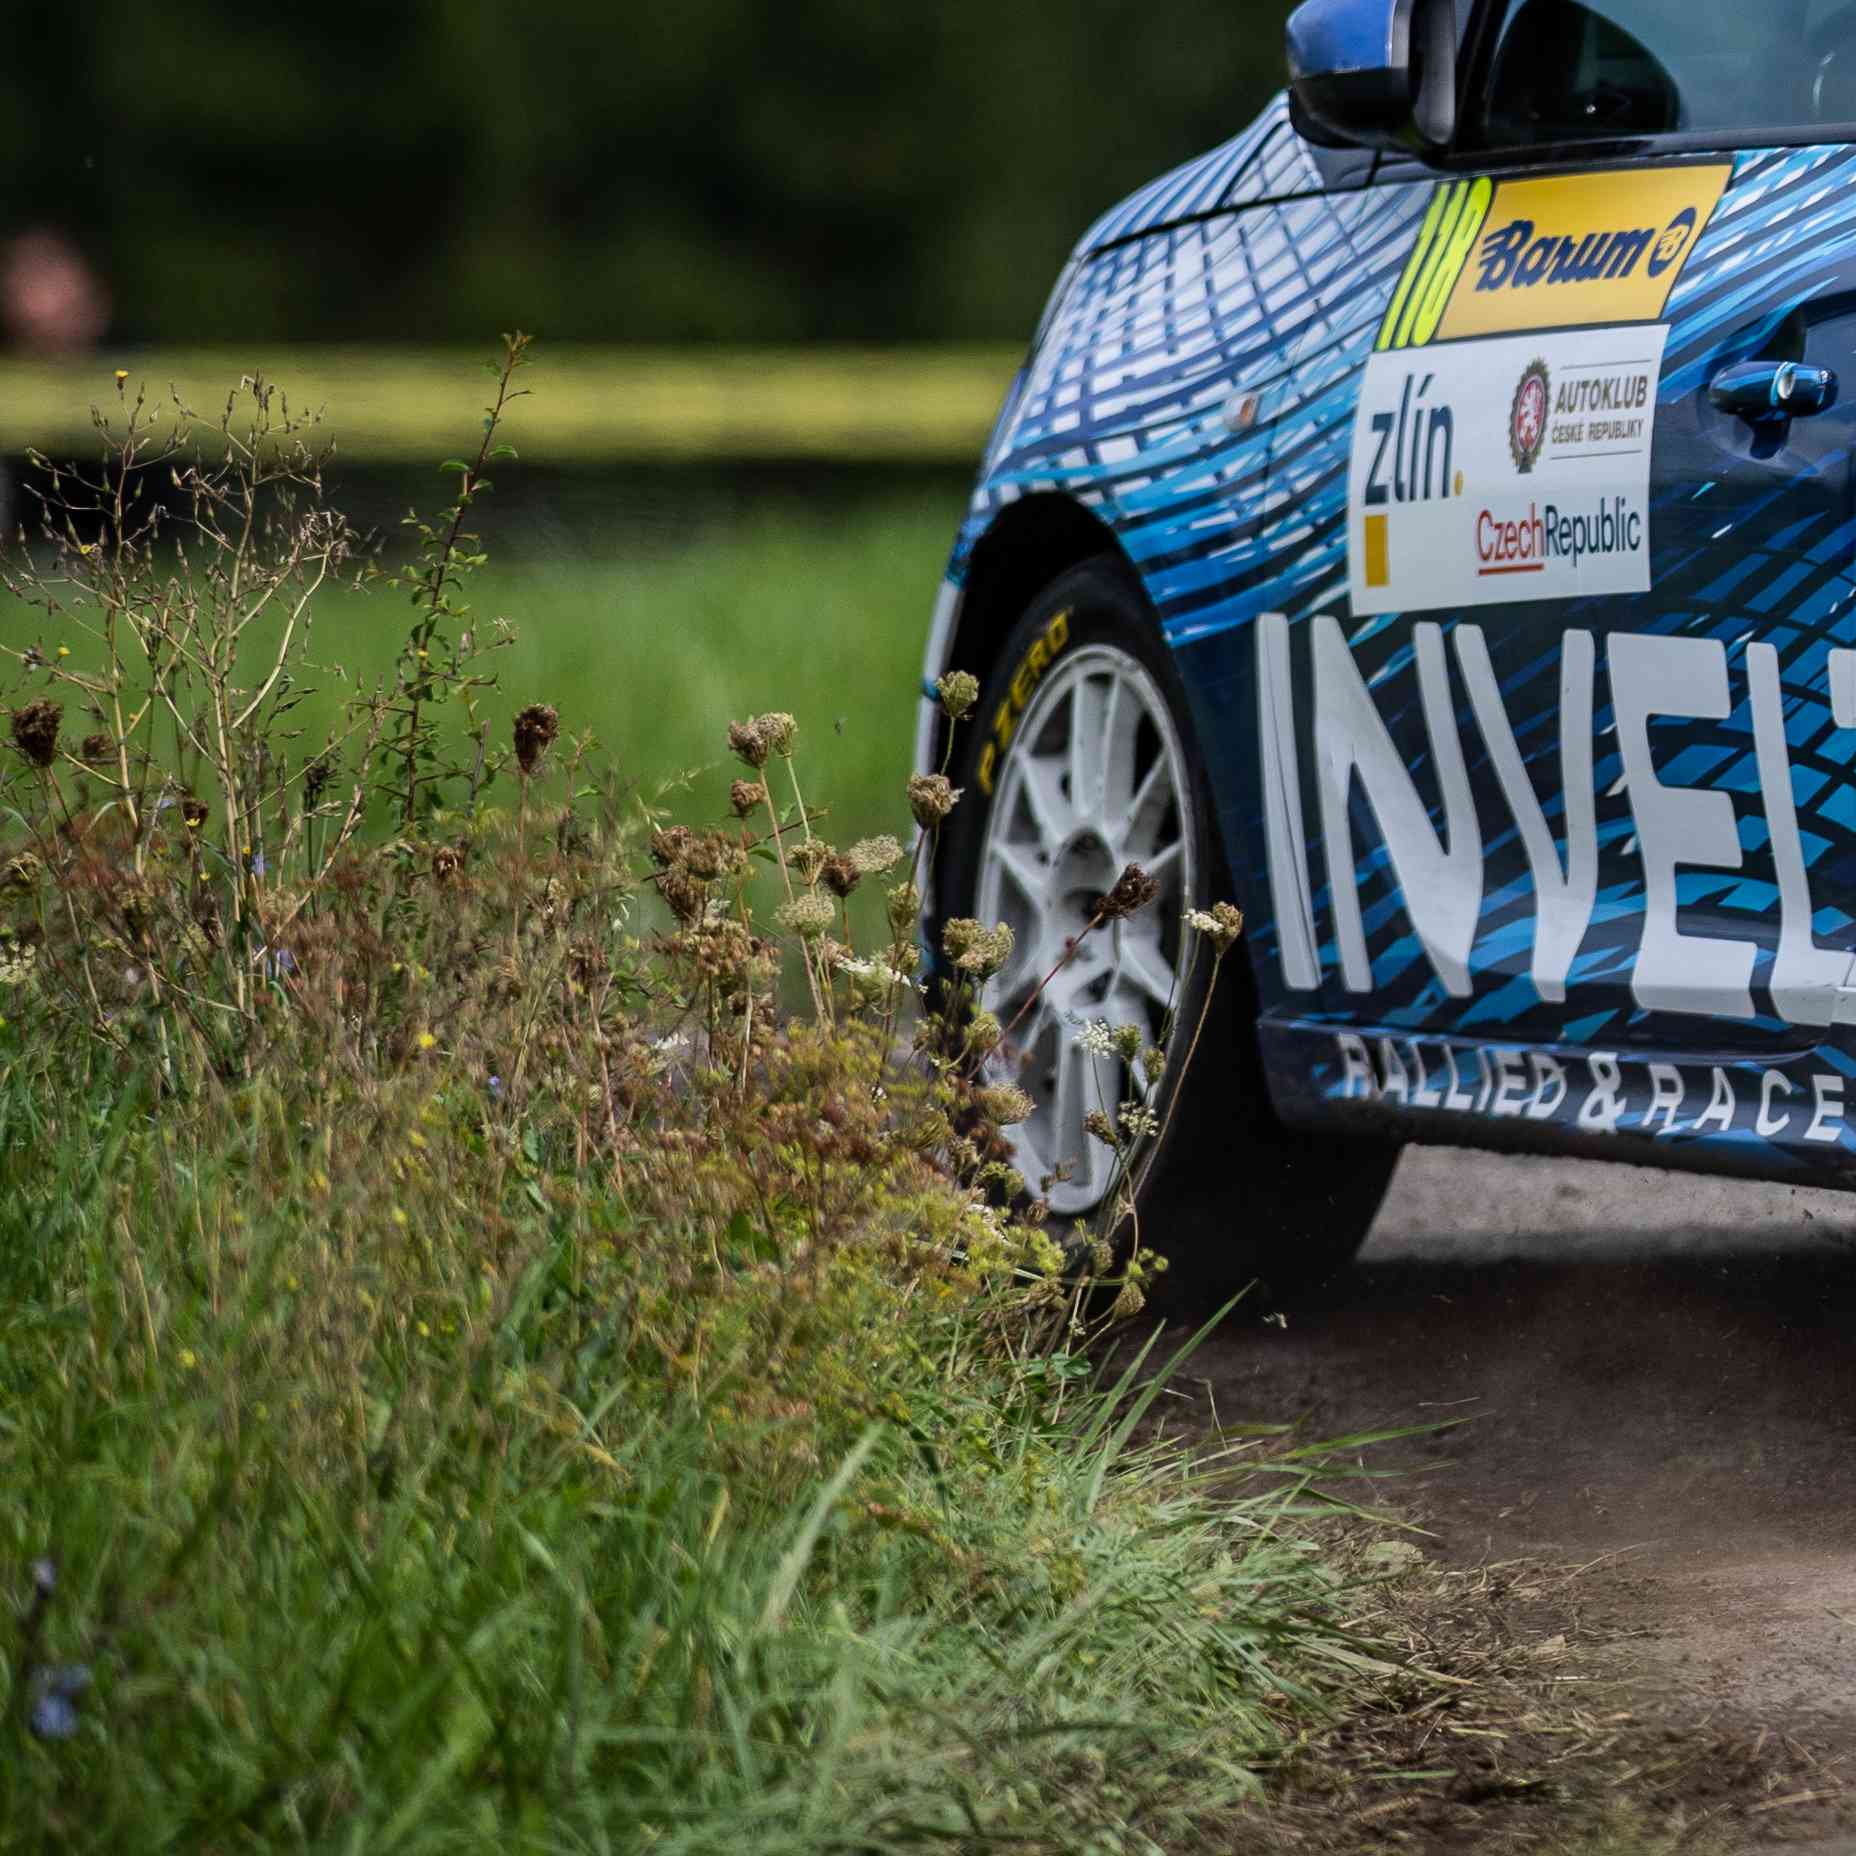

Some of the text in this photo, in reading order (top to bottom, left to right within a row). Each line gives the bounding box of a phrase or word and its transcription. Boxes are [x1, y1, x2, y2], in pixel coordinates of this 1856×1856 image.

[1476, 219, 1656, 292] Barum
[1554, 375, 1648, 414] AUTOKLUB
[1337, 1030, 1567, 1120] RALLIED
[1577, 1051, 1627, 1134] &
